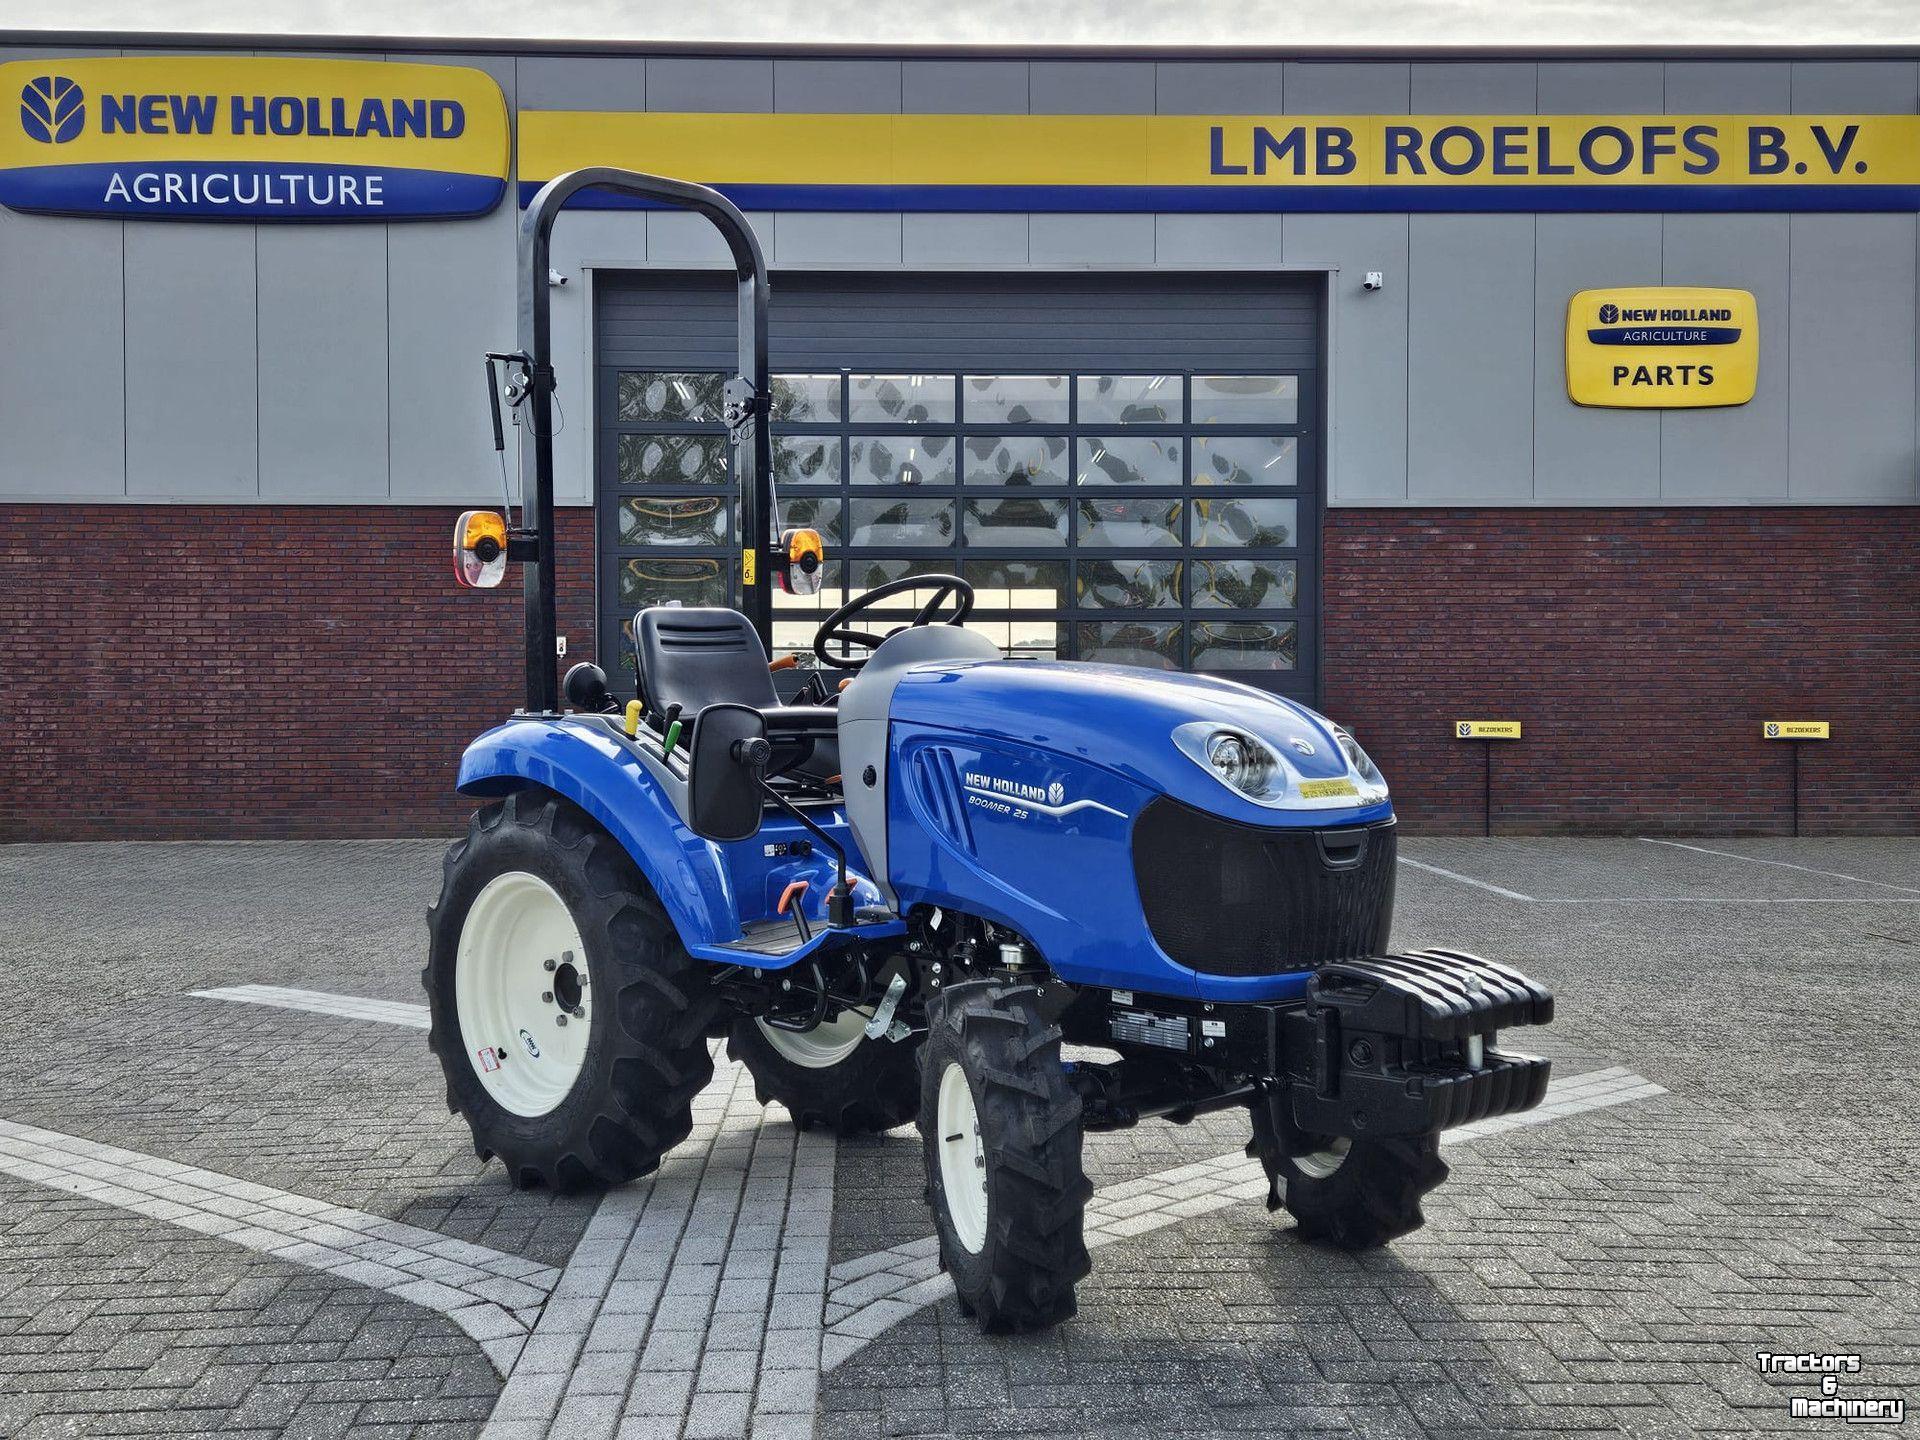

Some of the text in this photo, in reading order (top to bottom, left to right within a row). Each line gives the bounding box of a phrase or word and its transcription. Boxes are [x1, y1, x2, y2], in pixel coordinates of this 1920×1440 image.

[101, 93, 466, 139] NEW HOLLAND
[1210, 125, 1868, 177] LMB ROELOFS B.V.
[103, 172, 384, 206] AGRICULTURE
[1621, 309, 1732, 322] NEW HOLLAND
[1622, 331, 1707, 342] AGRICULTURE
[1613, 365, 1715, 386] PARTS
[965, 772, 1045, 801] NEW HOLLAND
[968, 796, 1028, 819] BOOMER 25
